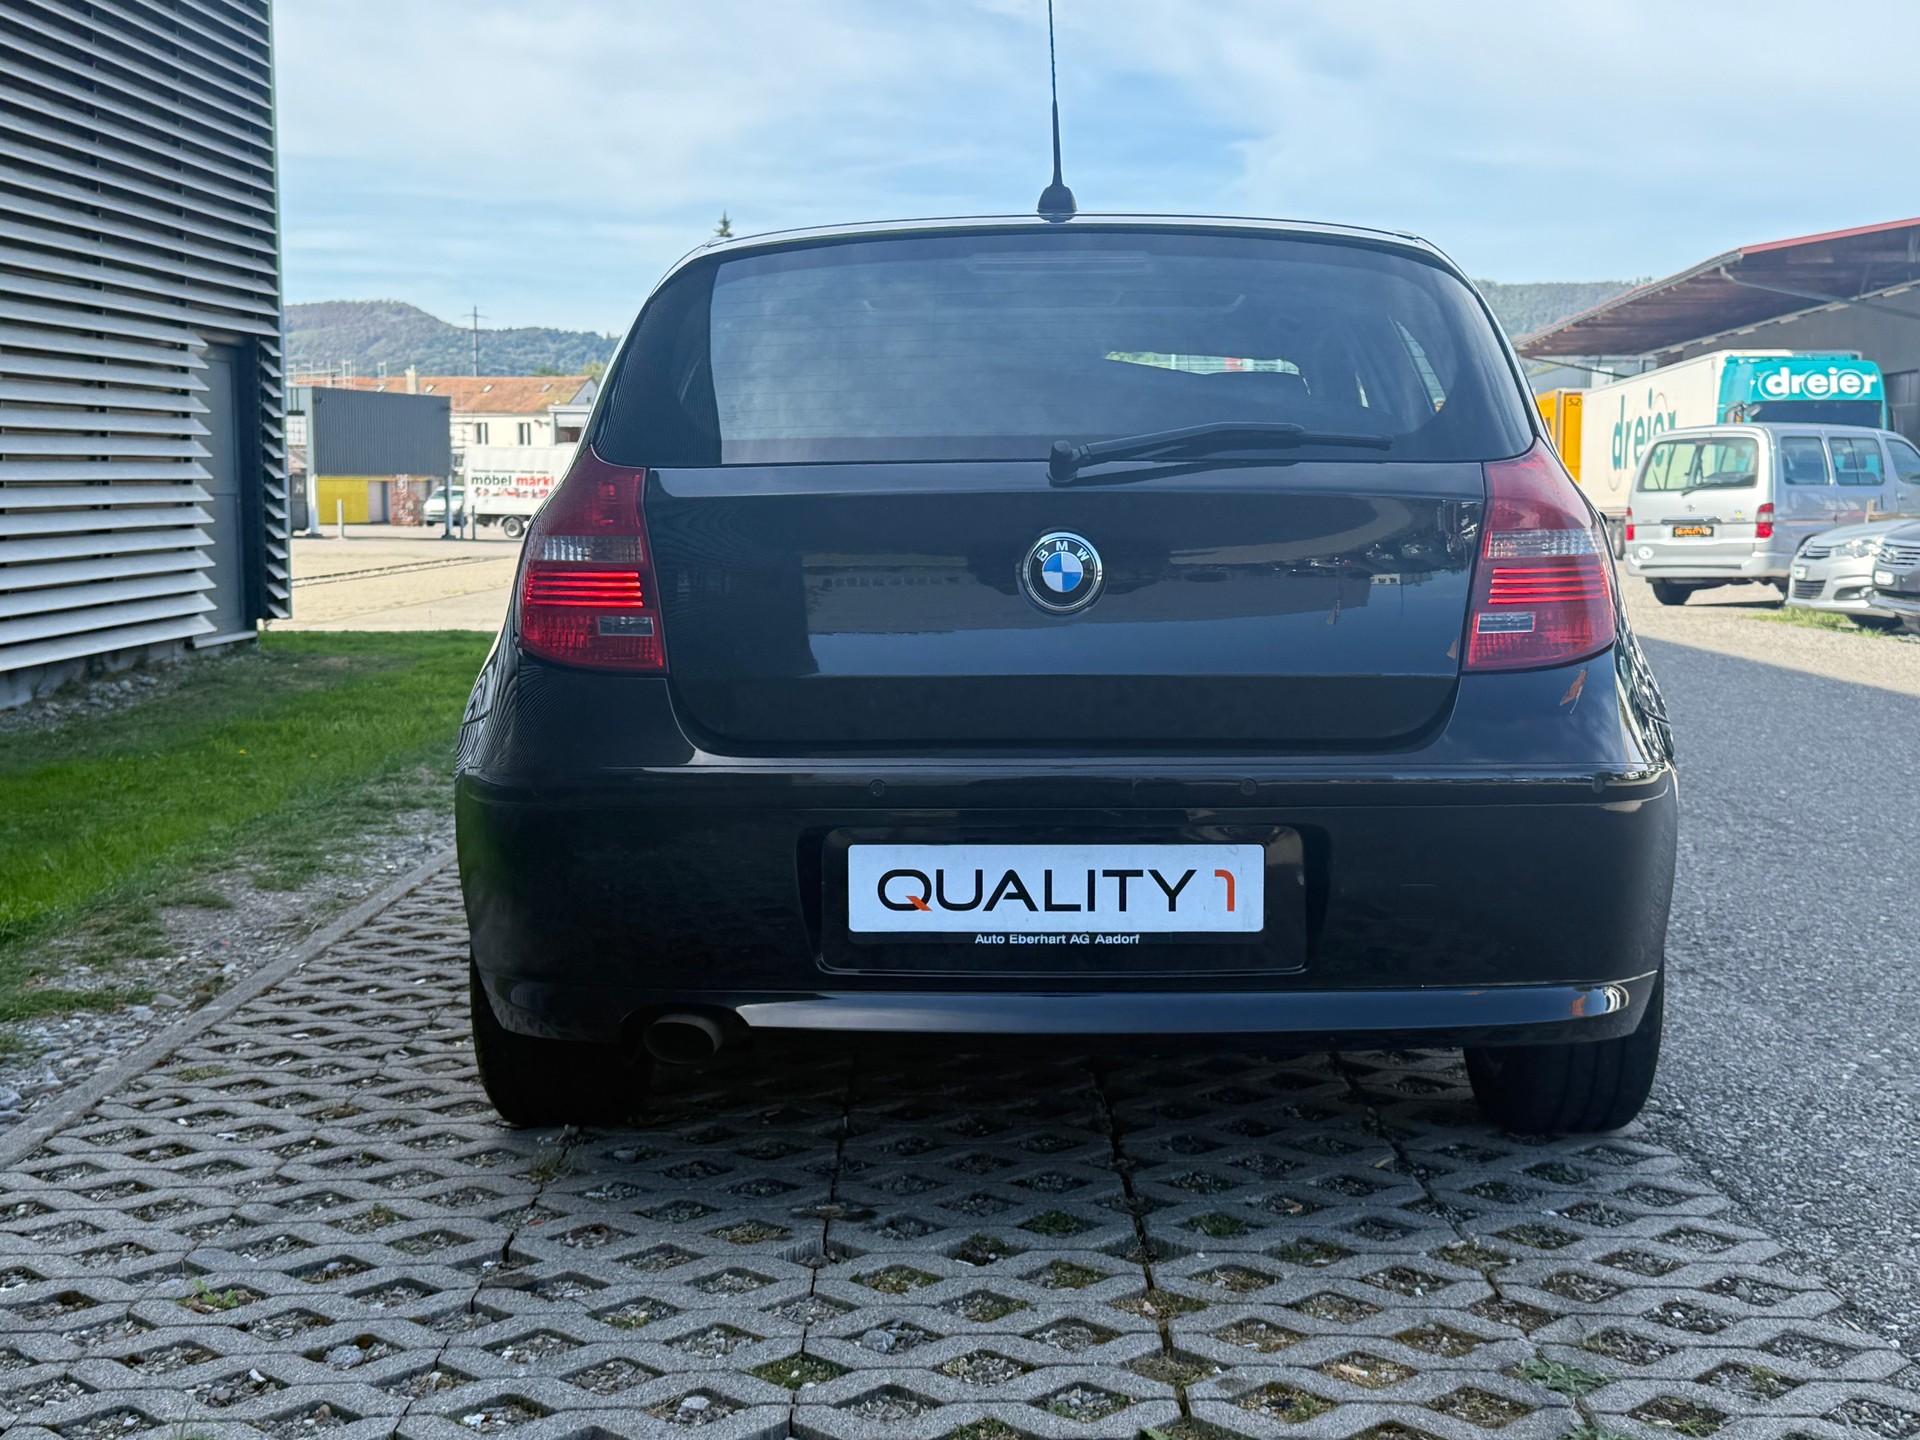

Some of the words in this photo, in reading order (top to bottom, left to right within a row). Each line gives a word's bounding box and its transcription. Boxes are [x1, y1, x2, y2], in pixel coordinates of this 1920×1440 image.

[1765, 366, 1877, 395] dreier
[470, 474, 512, 486] möbel
[516, 476, 555, 487] märki
[1036, 541, 1090, 562] BMW
[877, 868, 1197, 912] QUALITY
[1214, 869, 1236, 912] 1
[975, 933, 1006, 945] Auto
[1009, 933, 1067, 945] Eberhart
[1069, 933, 1090, 945] AG
[1095, 933, 1141, 945] Aadorf
